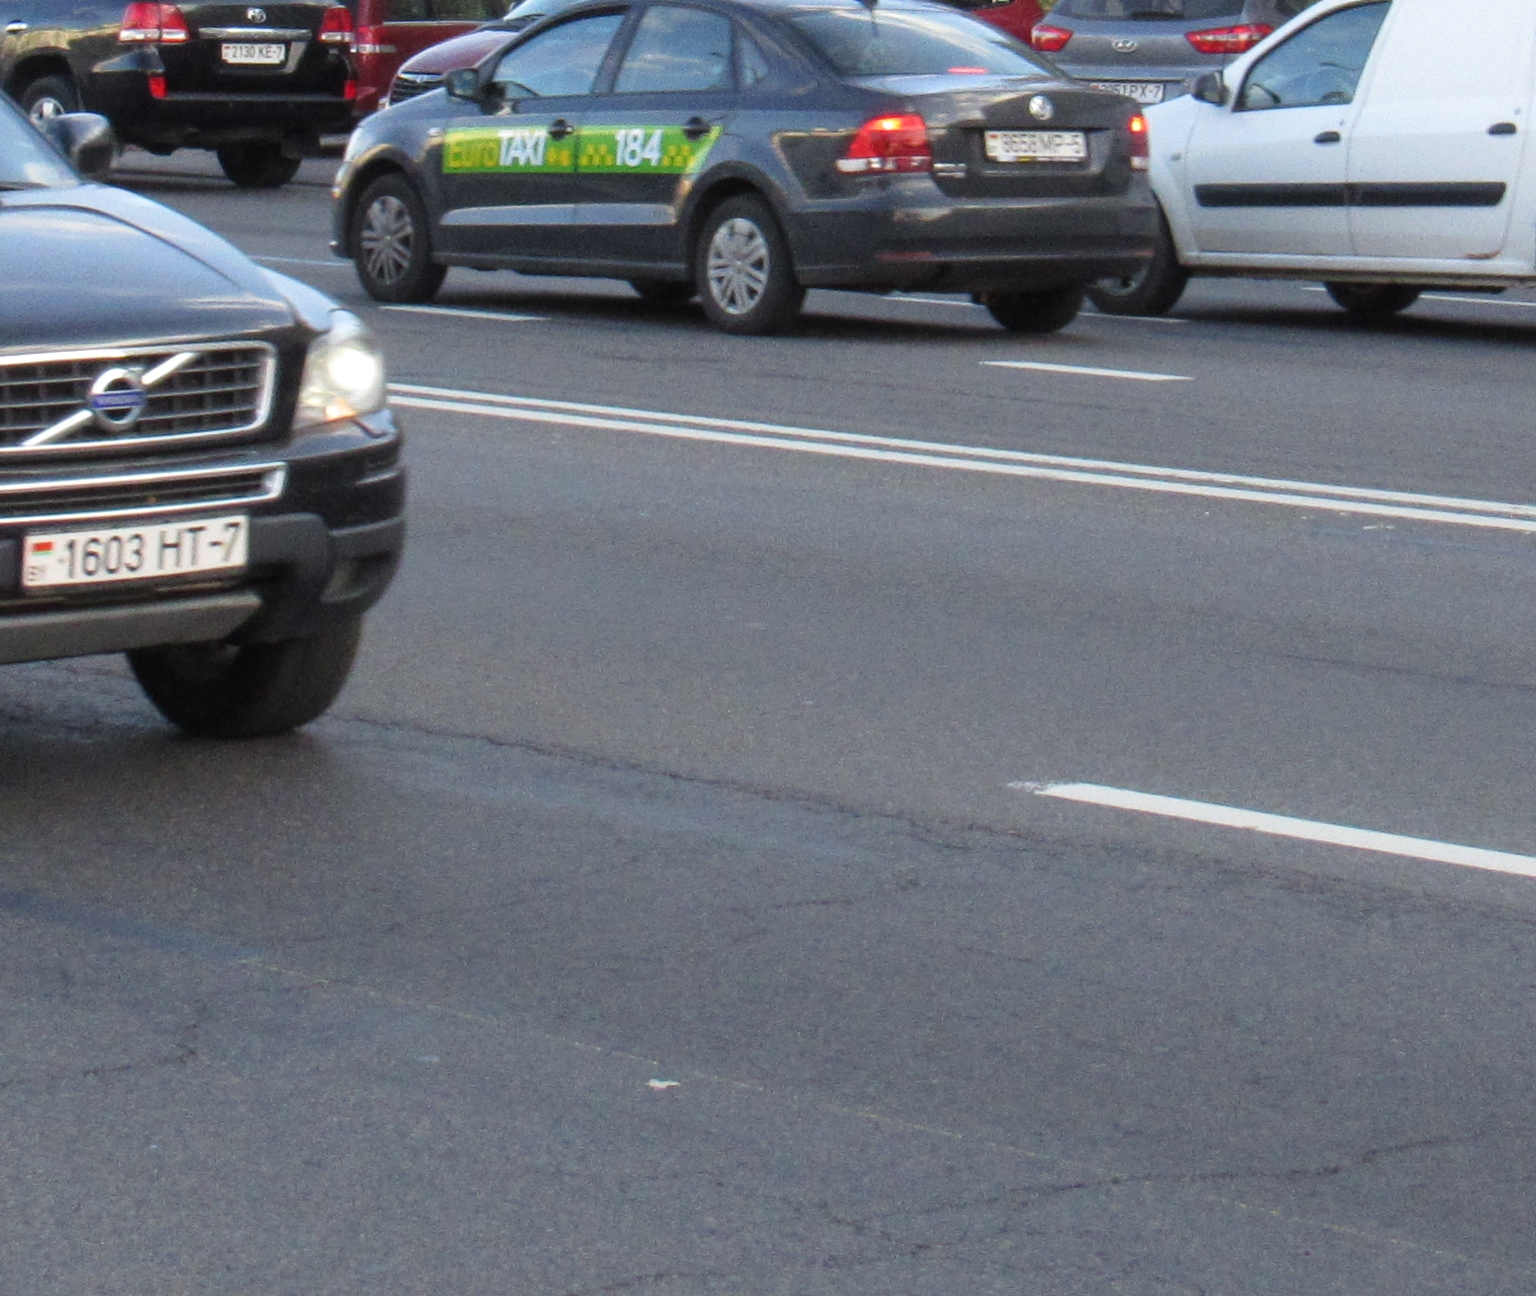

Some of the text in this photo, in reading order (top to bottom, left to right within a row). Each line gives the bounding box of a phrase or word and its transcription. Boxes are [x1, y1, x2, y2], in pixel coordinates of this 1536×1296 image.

[257, 45, 283, 58] KE-7
[615, 128, 663, 167] 184
[66, 521, 242, 579] 1603 HT-7
